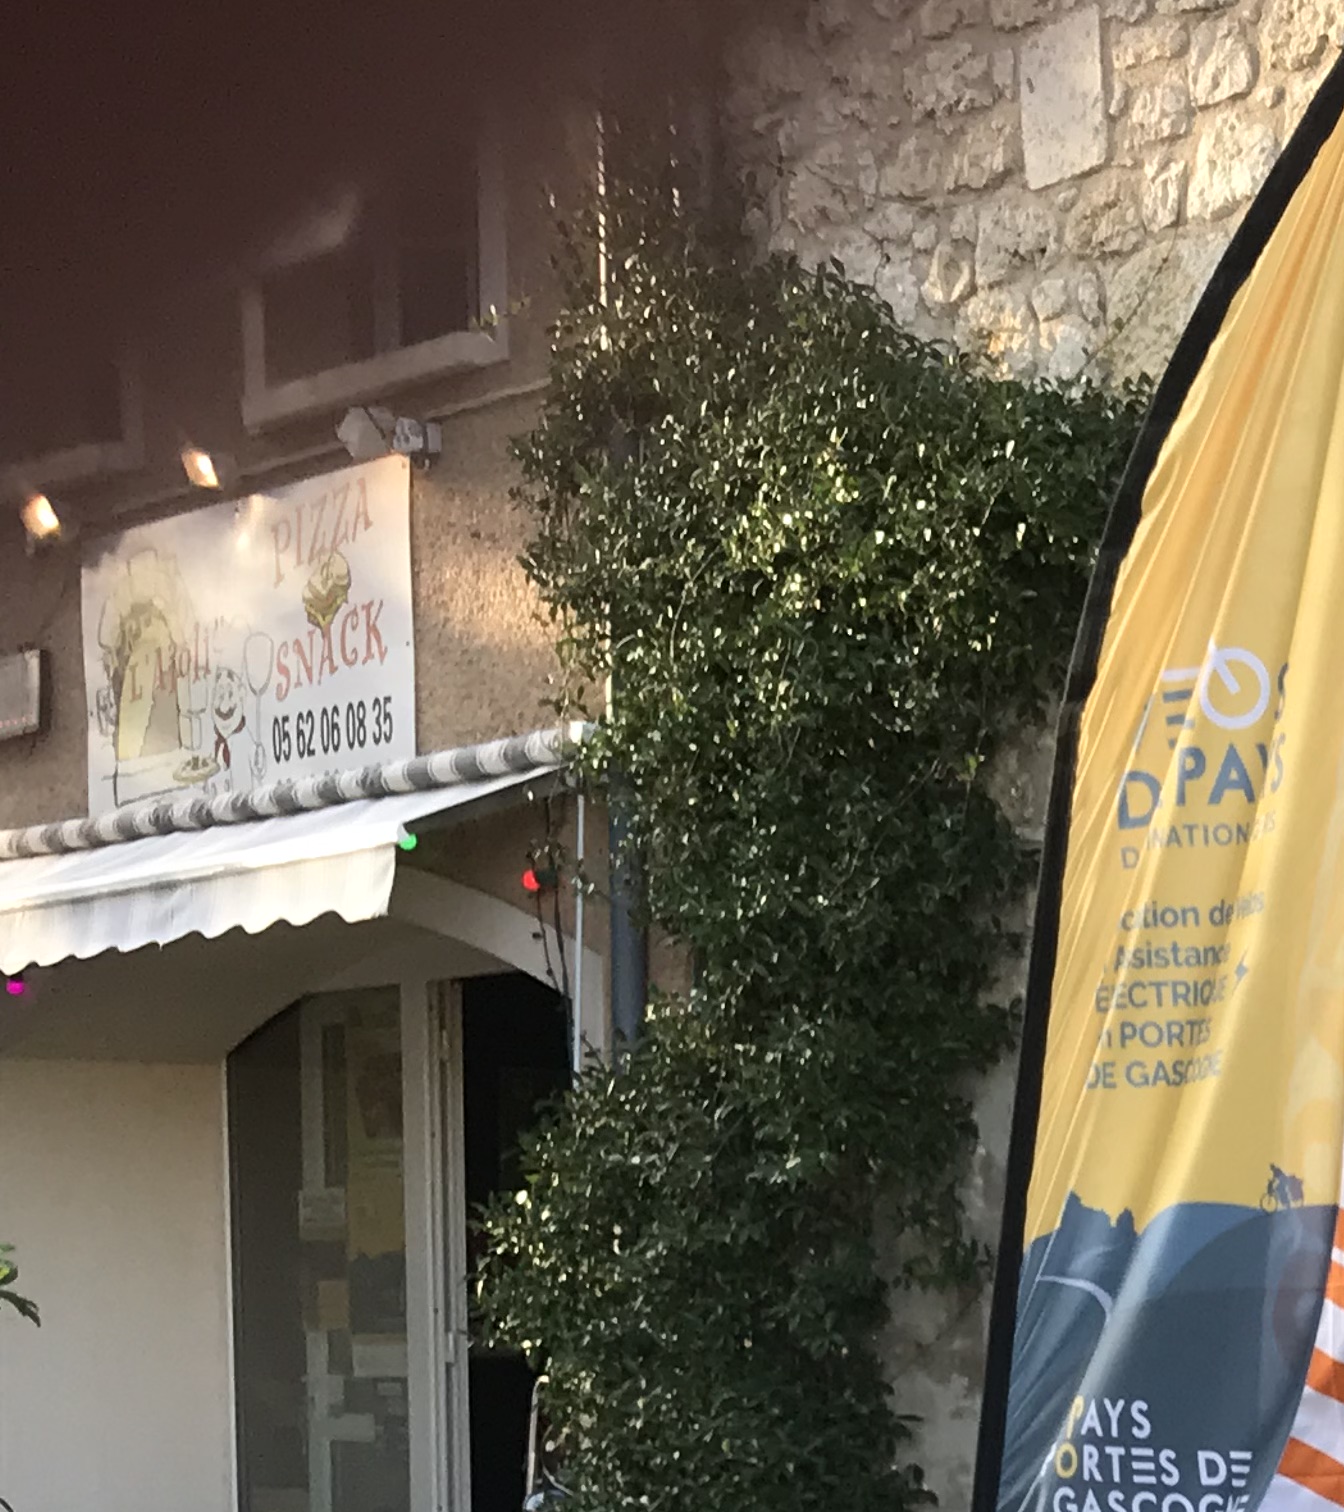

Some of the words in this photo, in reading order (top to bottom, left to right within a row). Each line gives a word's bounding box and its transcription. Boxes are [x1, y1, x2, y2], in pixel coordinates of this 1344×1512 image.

[271, 477, 373, 589] PIZZA
[275, 599, 388, 702] SNACK
[272, 715, 292, 764] 05
[296, 708, 316, 759] 62
[320, 703, 341, 755] 06
[346, 699, 367, 751] 08
[372, 694, 394, 746] 35
[1054, 1441, 1181, 1487] ORTES
[1196, 1449, 1253, 1488] DE
